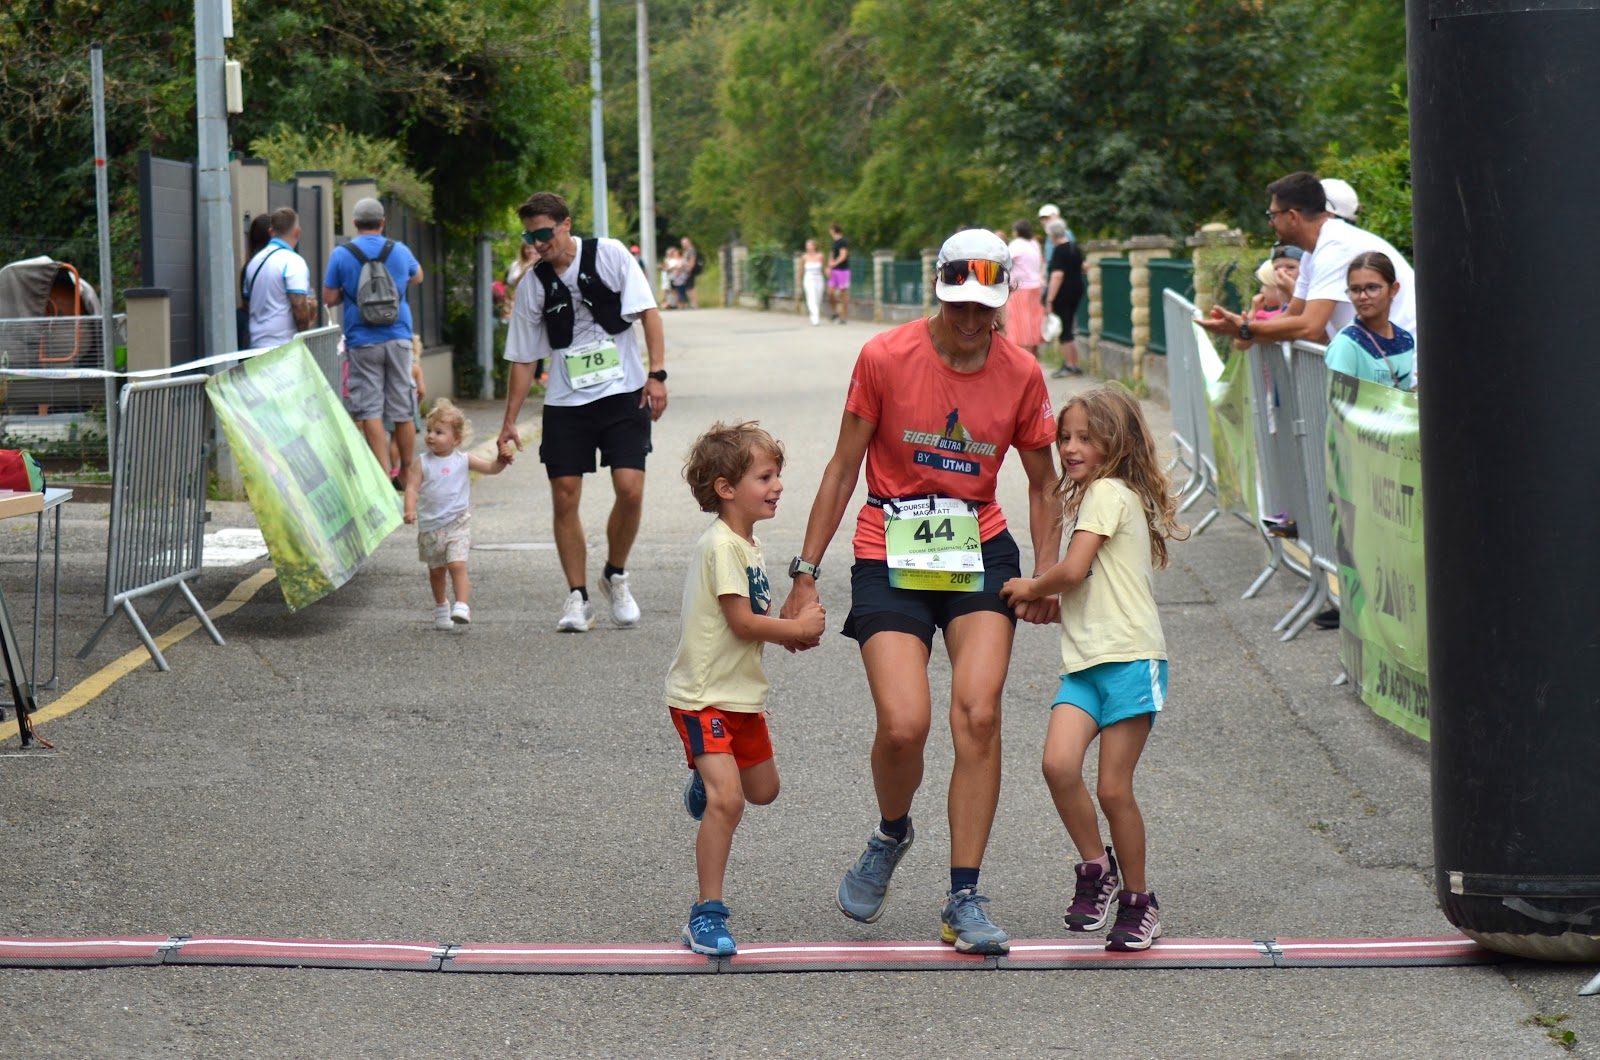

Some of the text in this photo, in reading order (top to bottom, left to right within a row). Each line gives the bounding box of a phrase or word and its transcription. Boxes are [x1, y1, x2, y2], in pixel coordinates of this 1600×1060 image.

[581, 352, 605, 369] 78
[902, 429, 998, 457] EIGER ULTRA TRAIL
[917, 452, 972, 473] BY UTMB
[899, 503, 930, 512] COURSES
[913, 518, 955, 544] 44
